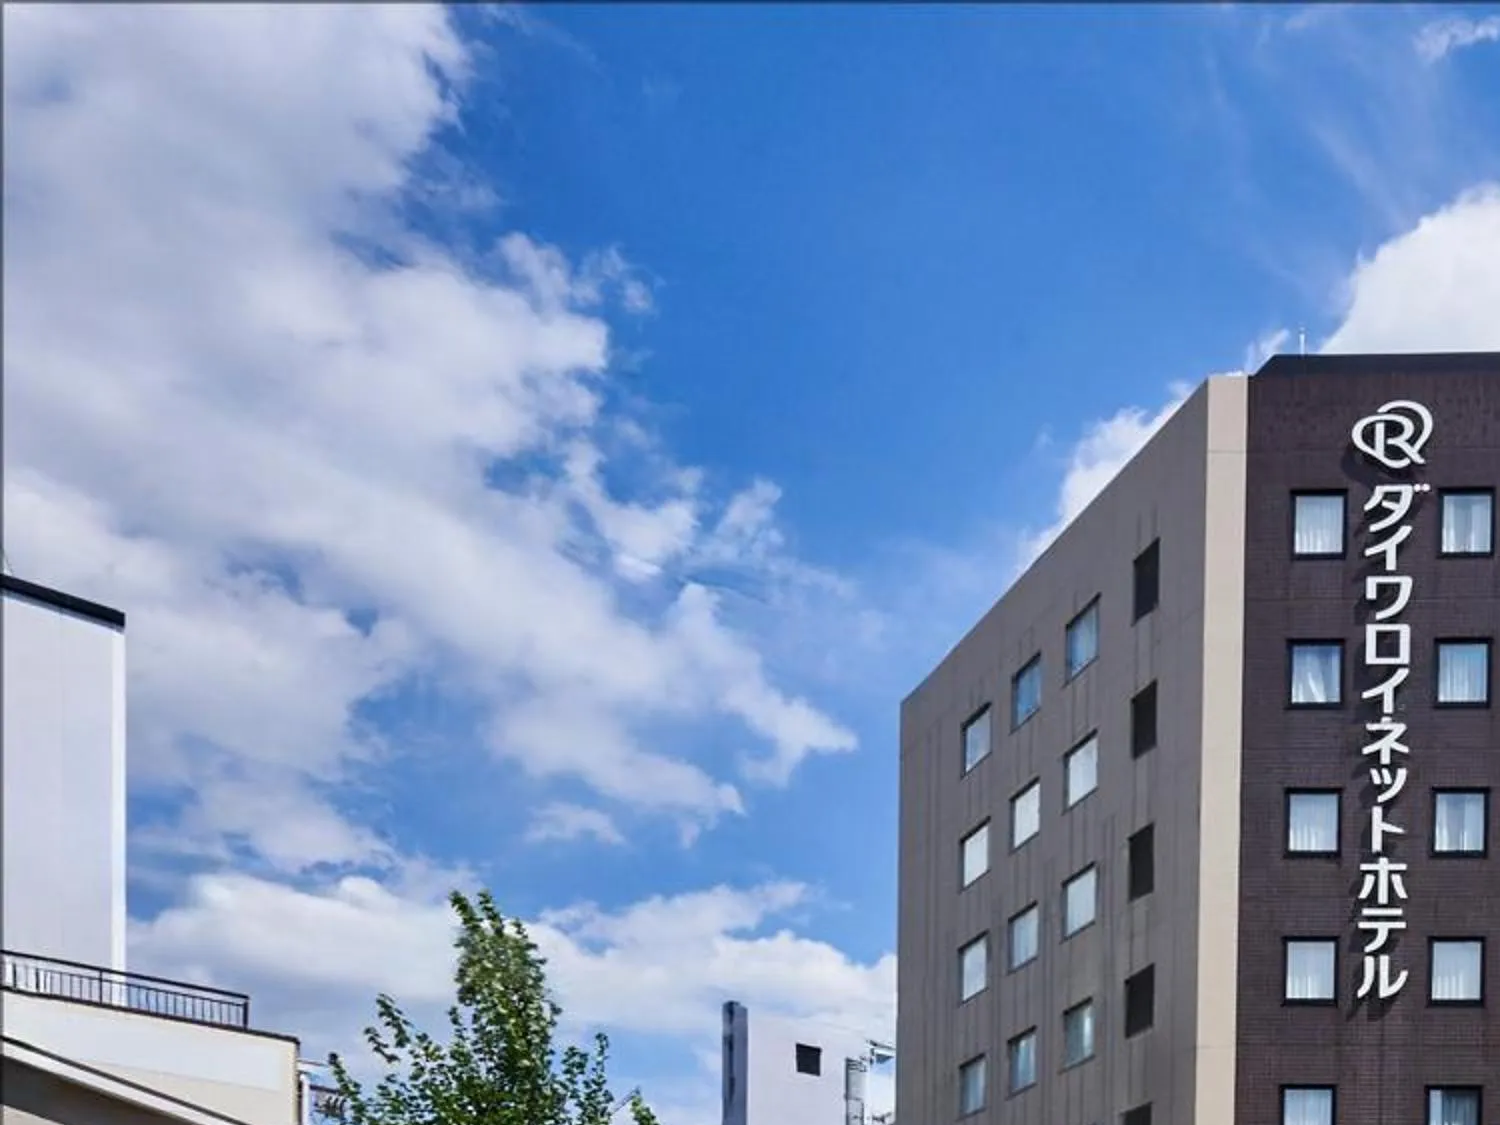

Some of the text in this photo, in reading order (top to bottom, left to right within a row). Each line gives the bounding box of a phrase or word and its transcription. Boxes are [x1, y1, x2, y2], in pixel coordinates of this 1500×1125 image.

[1357, 483, 1431, 999] ダイワロイネットホテル
